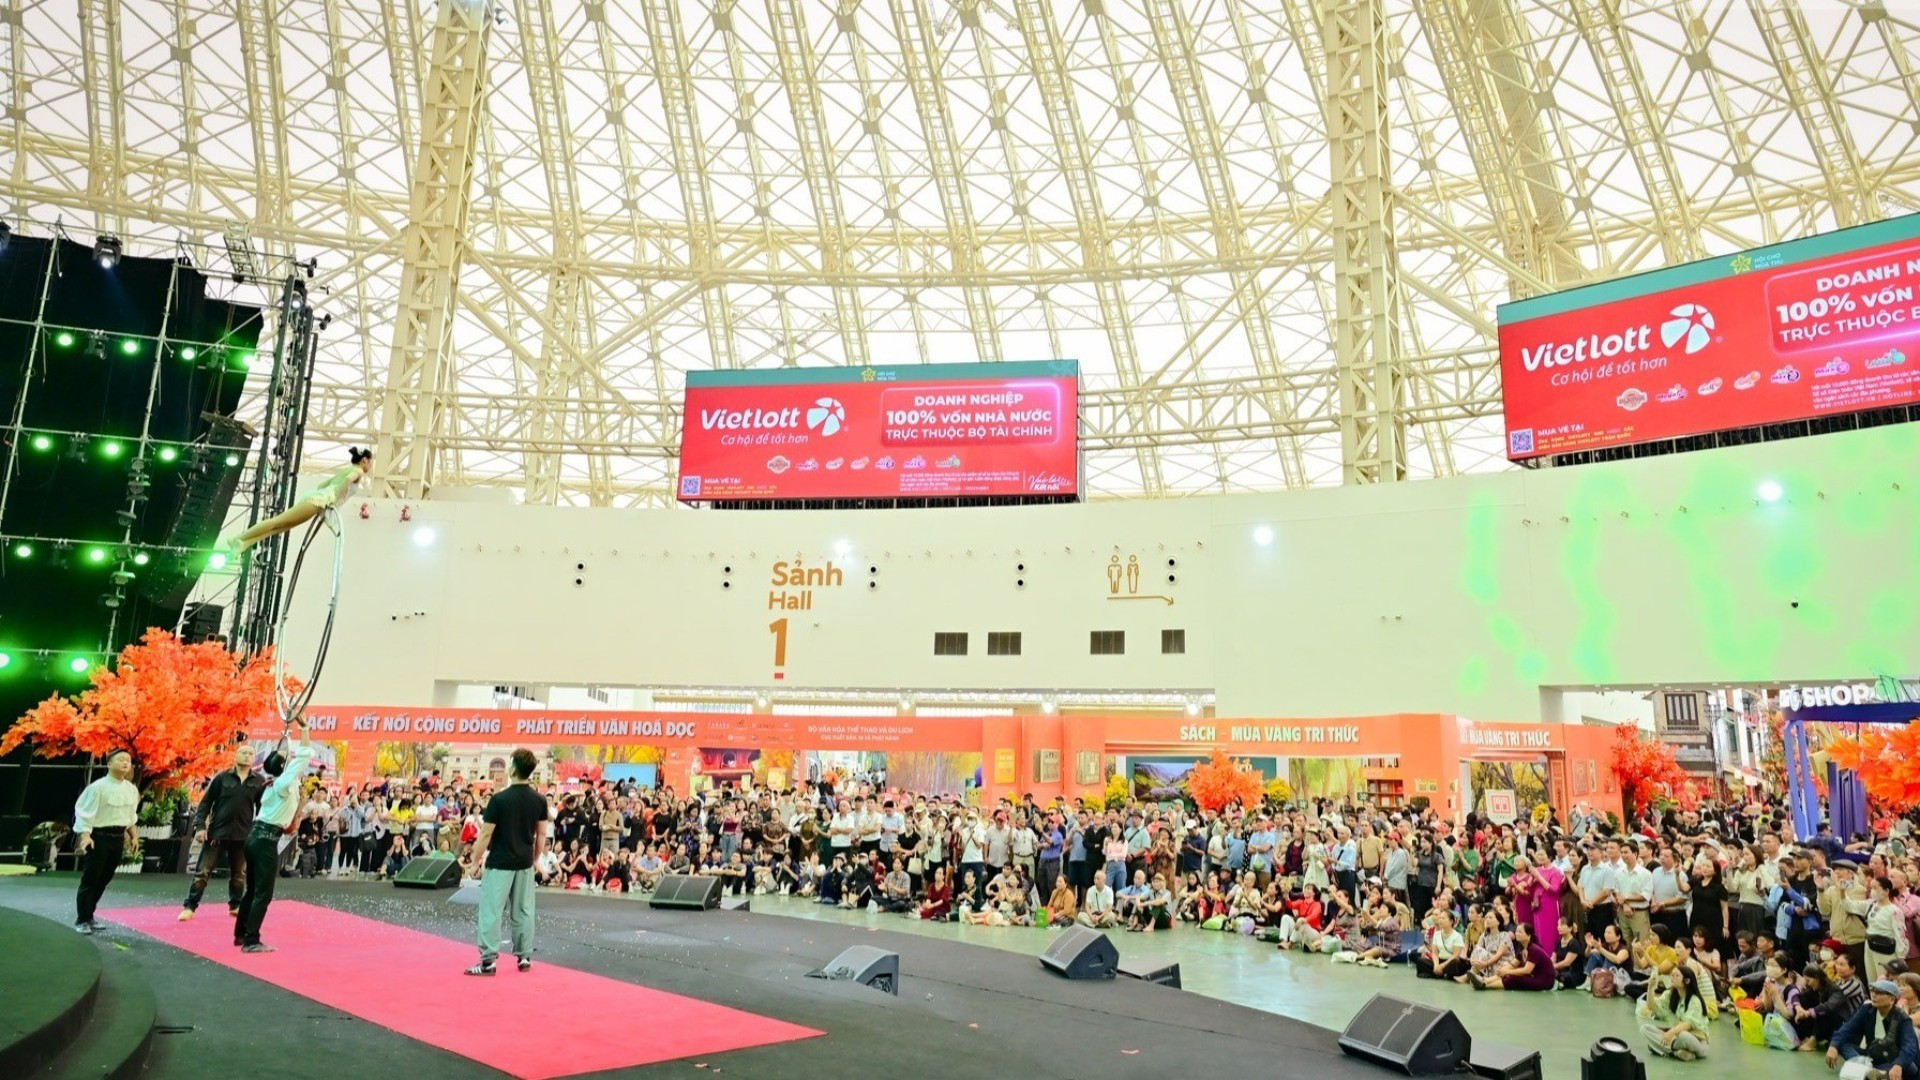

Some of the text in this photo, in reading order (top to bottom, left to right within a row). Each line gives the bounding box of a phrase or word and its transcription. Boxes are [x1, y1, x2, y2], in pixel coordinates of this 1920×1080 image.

[1816, 263, 1899, 292] DOANH
[1776, 284, 1913, 324] 100% VỐN
[1779, 322, 1830, 343] TRỰC
[1835, 309, 1906, 333] THUỘC
[1521, 324, 1651, 371] Vietlott
[1551, 356, 1667, 386] Cơ hội để tốt hơn
[914, 391, 1024, 407] DOANH NGHIỆP
[701, 407, 800, 430] Vietlott
[886, 408, 1052, 425] 100% VỐN NHÀ NƯỚC
[721, 432, 808, 446] Cơ hội để tốt hơn
[886, 425, 1052, 441] TRỰC THUỘC BỘ TÀI CHÍNH
[771, 559, 843, 587] Sảnh
[768, 590, 812, 610] Hall
[769, 618, 788, 666] 1
[307, 713, 337, 731] ÁCH
[353, 711, 381, 731] KẾT
[383, 713, 411, 732] NỐI
[414, 714, 455, 734] CỘNG
[459, 713, 501, 734] ĐỒNG
[516, 717, 554, 735] PHÁT
[556, 715, 596, 736] TRIỂN
[600, 718, 631, 736] VĂN
[632, 718, 662, 736] HOÁ
[666, 722, 695, 739] ĐỌC
[1180, 722, 1360, 743] SÁCH MÙA VÀNG TRI THỨC
[1503, 731, 1520, 746] TRI
[1522, 728, 1551, 746] THỨC
